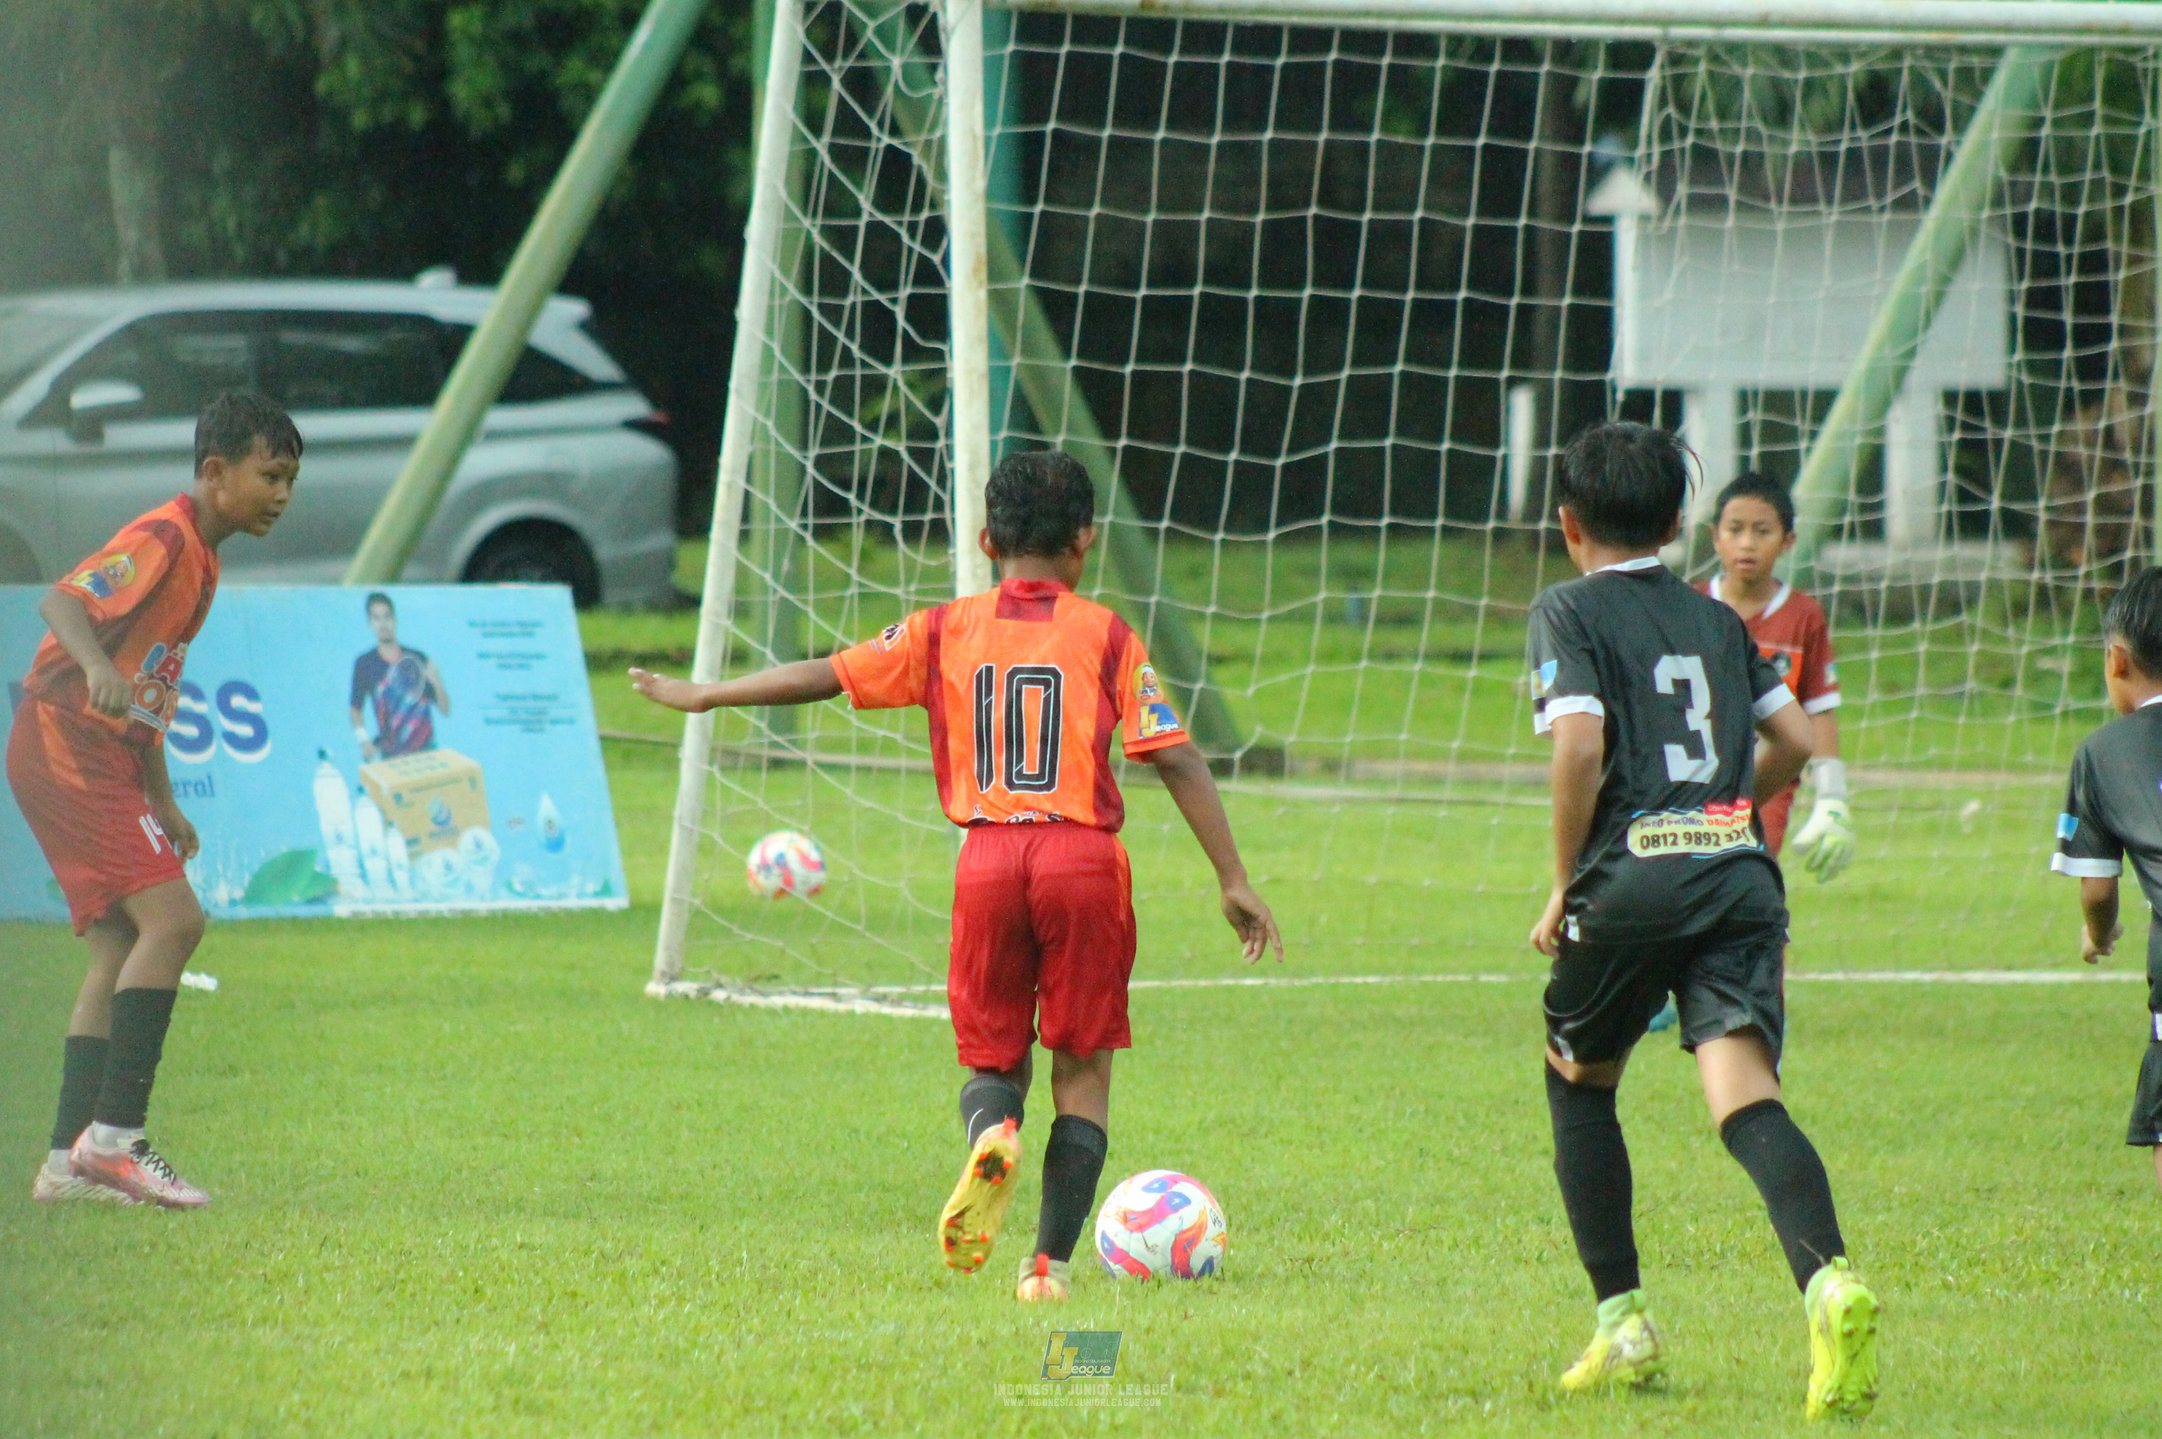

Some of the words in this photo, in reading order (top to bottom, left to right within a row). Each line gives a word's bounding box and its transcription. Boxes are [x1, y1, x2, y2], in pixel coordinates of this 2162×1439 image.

[165, 680, 271, 764] SS
[973, 663, 1064, 794] 10
[1653, 655, 1720, 784] 3
[172, 774, 216, 798] eral
[1640, 832, 1679, 850] 0812
[1682, 831, 1721, 848] 9892
